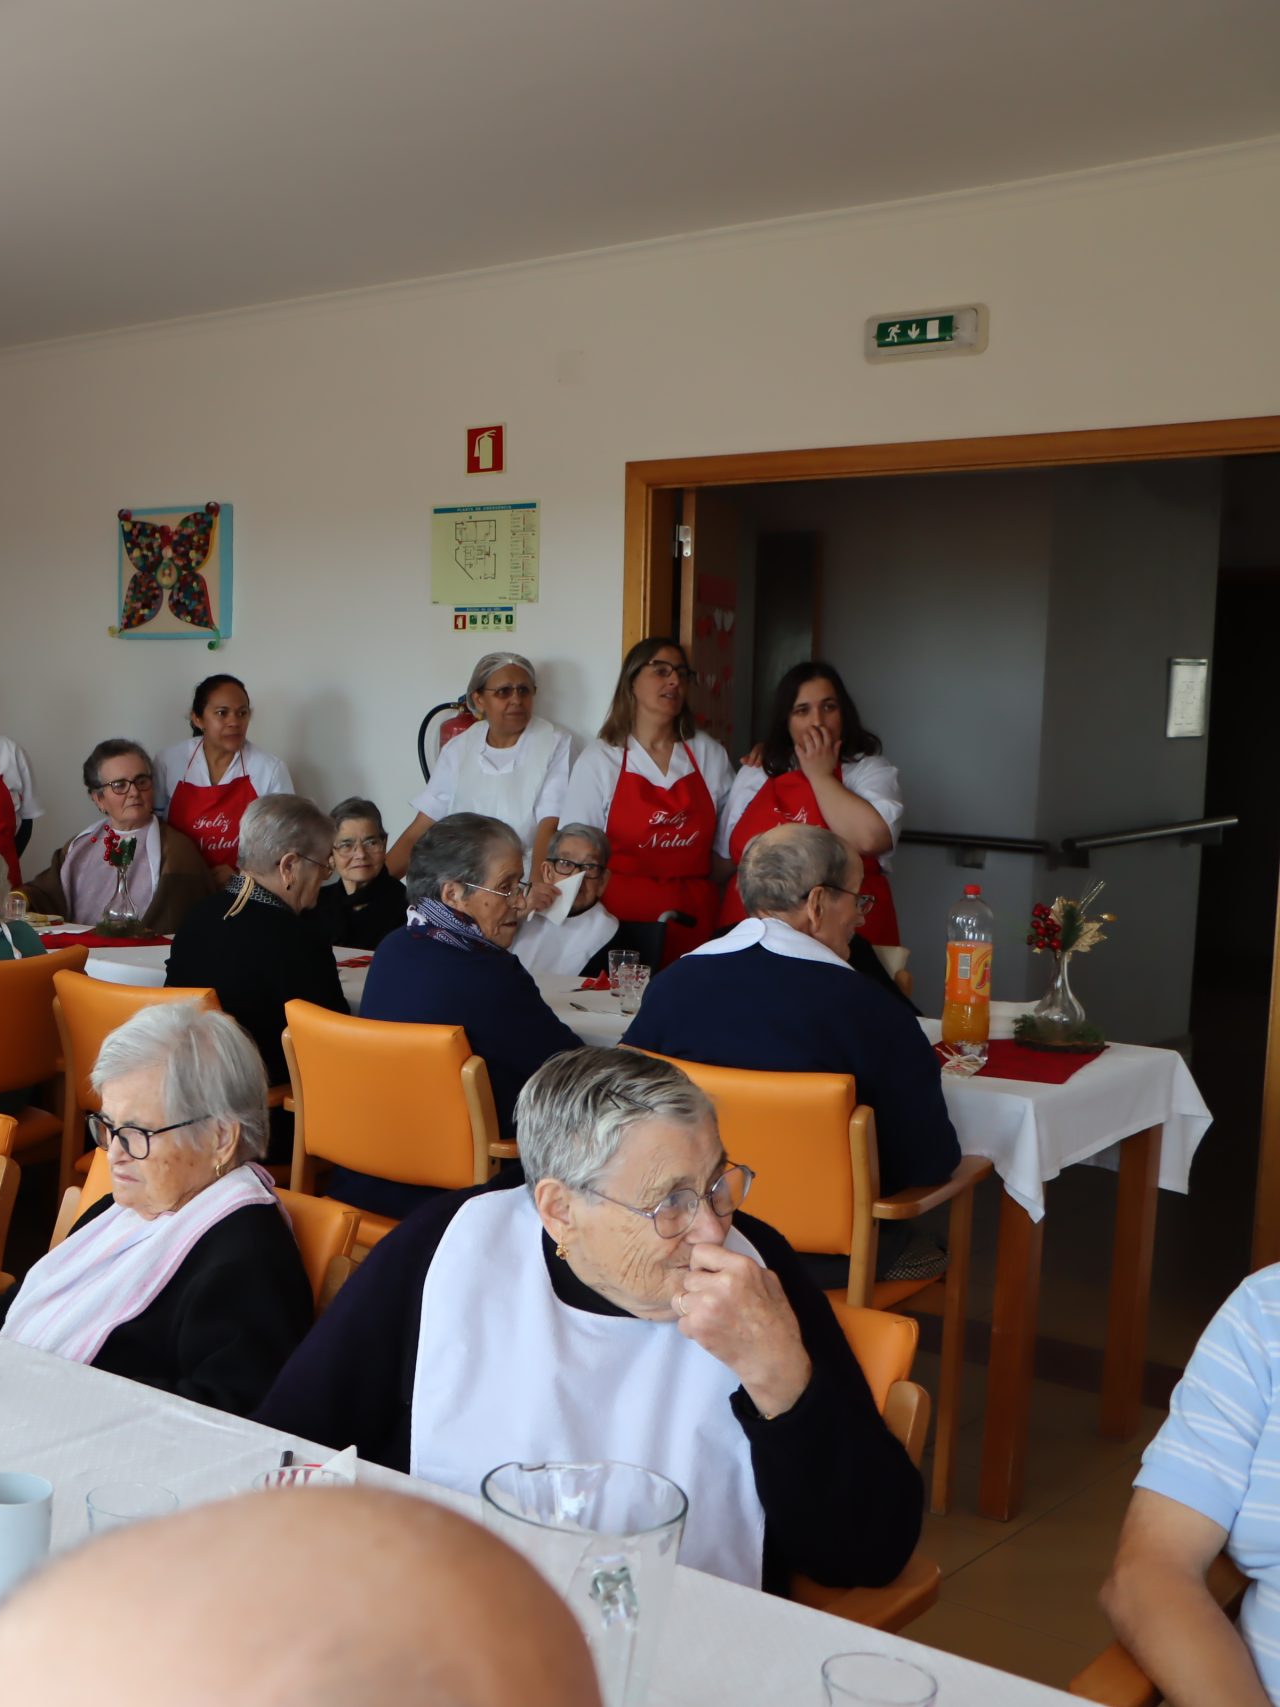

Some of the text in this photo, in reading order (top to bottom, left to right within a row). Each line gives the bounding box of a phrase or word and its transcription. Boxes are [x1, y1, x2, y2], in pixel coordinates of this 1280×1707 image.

[192, 811, 231, 833] Feliz
[648, 809, 688, 830] Feliz
[638, 830, 699, 849] Natal
